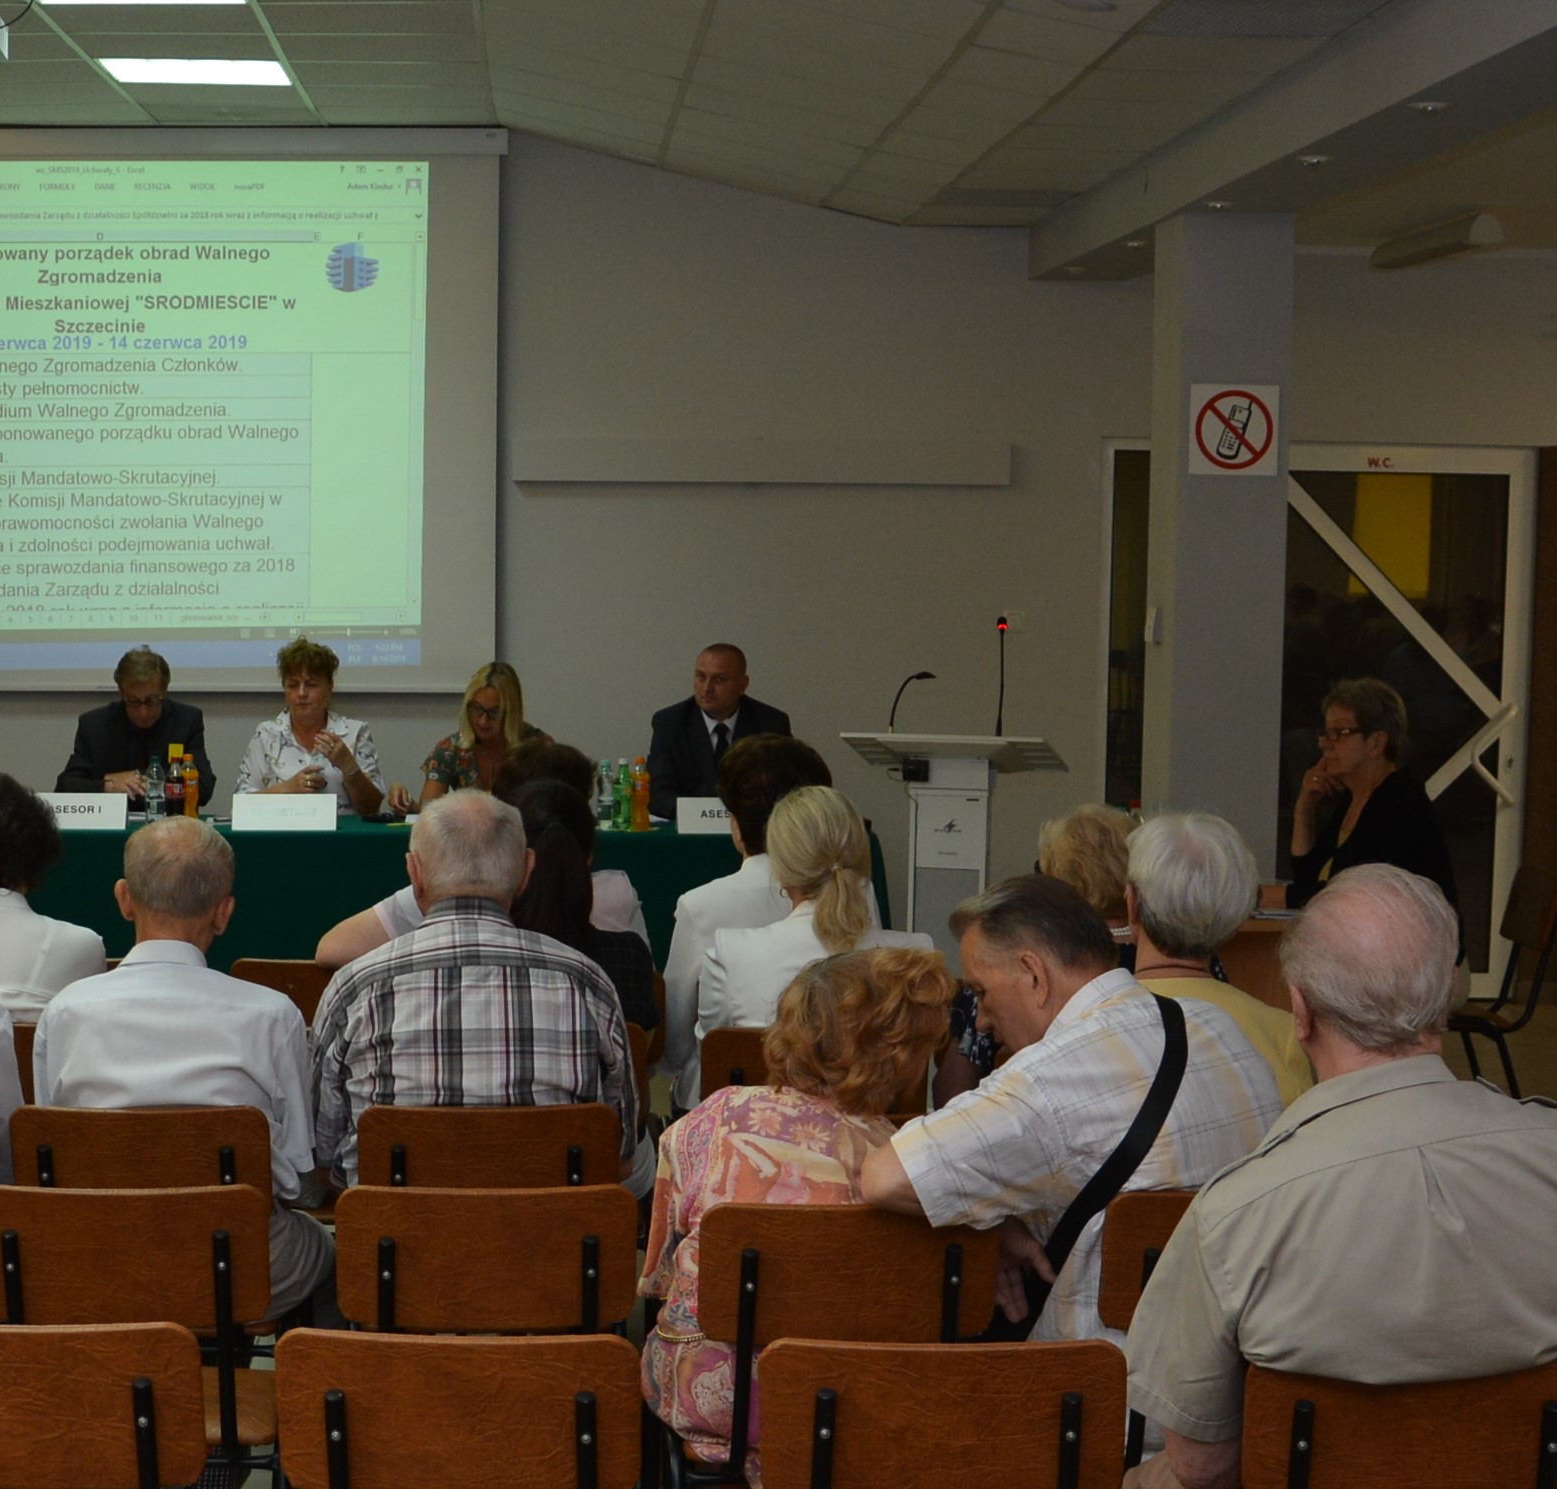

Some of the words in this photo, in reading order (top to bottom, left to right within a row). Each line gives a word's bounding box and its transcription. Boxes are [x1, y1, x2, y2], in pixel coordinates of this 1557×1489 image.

[94, 183, 115, 191] DANE
[134, 183, 171, 191] RECENZJA
[190, 183, 215, 191] WIDOK
[347, 182, 368, 191] Adam
[43, 211, 75, 221] Zarządu
[82, 210, 130, 220] działalności
[132, 210, 178, 221] Spółdzielni
[190, 211, 208, 219] 2018
[211, 210, 223, 219] rok
[253, 210, 296, 221] informacją
[305, 210, 342, 221] realizacji
[343, 210, 372, 219] uchwał
[96, 232, 104, 241] D
[314, 232, 320, 240] E
[357, 232, 363, 240] F
[54, 245, 134, 264] porządek
[139, 245, 190, 260] obrad
[195, 245, 270, 263] Walnego
[37, 268, 162, 287] Zgromadzenia
[5, 295, 130, 313] Mieszkaniowej
[283, 298, 296, 310] w
[54, 319, 146, 334] Szczecinie
[52, 335, 92, 350] 2019
[108, 335, 128, 350] 14
[133, 337, 202, 349] czerwca
[208, 335, 247, 349] 2019
[42, 357, 156, 375] Zgromadzenia
[161, 357, 243, 373] Członków.
[22, 380, 144, 398] pełnomocnictw.
[37, 402, 109, 421] Walnego
[114, 402, 231, 420] Zgromadzenia.
[100, 425, 172, 442] porządku
[177, 425, 223, 439] obrad
[228, 424, 299, 442] Walnego
[1367, 457, 1394, 468] W.C.
[21, 469, 220, 487] Mandatowo-Skrutacyjnej.
[8, 493, 65, 511] Komisji
[70, 491, 265, 509] Mandatowo-Skrutacyjnej
[269, 495, 282, 506] w
[119, 514, 188, 529] zwołania
[192, 514, 264, 531] Walnego
[18, 538, 92, 553] zdolności
[98, 536, 211, 555] podejmowania
[215, 536, 274, 551] uchwał.
[17, 559, 124, 577] sprawozdania
[129, 559, 228, 576] finansowego
[233, 561, 251, 572] za
[256, 558, 295, 572] 2018
[44, 582, 109, 599] Zarządu
[114, 584, 123, 595] z
[128, 581, 220, 596] działalności
[50, 804, 95, 814] SESOR
[700, 809, 731, 819] ASES
